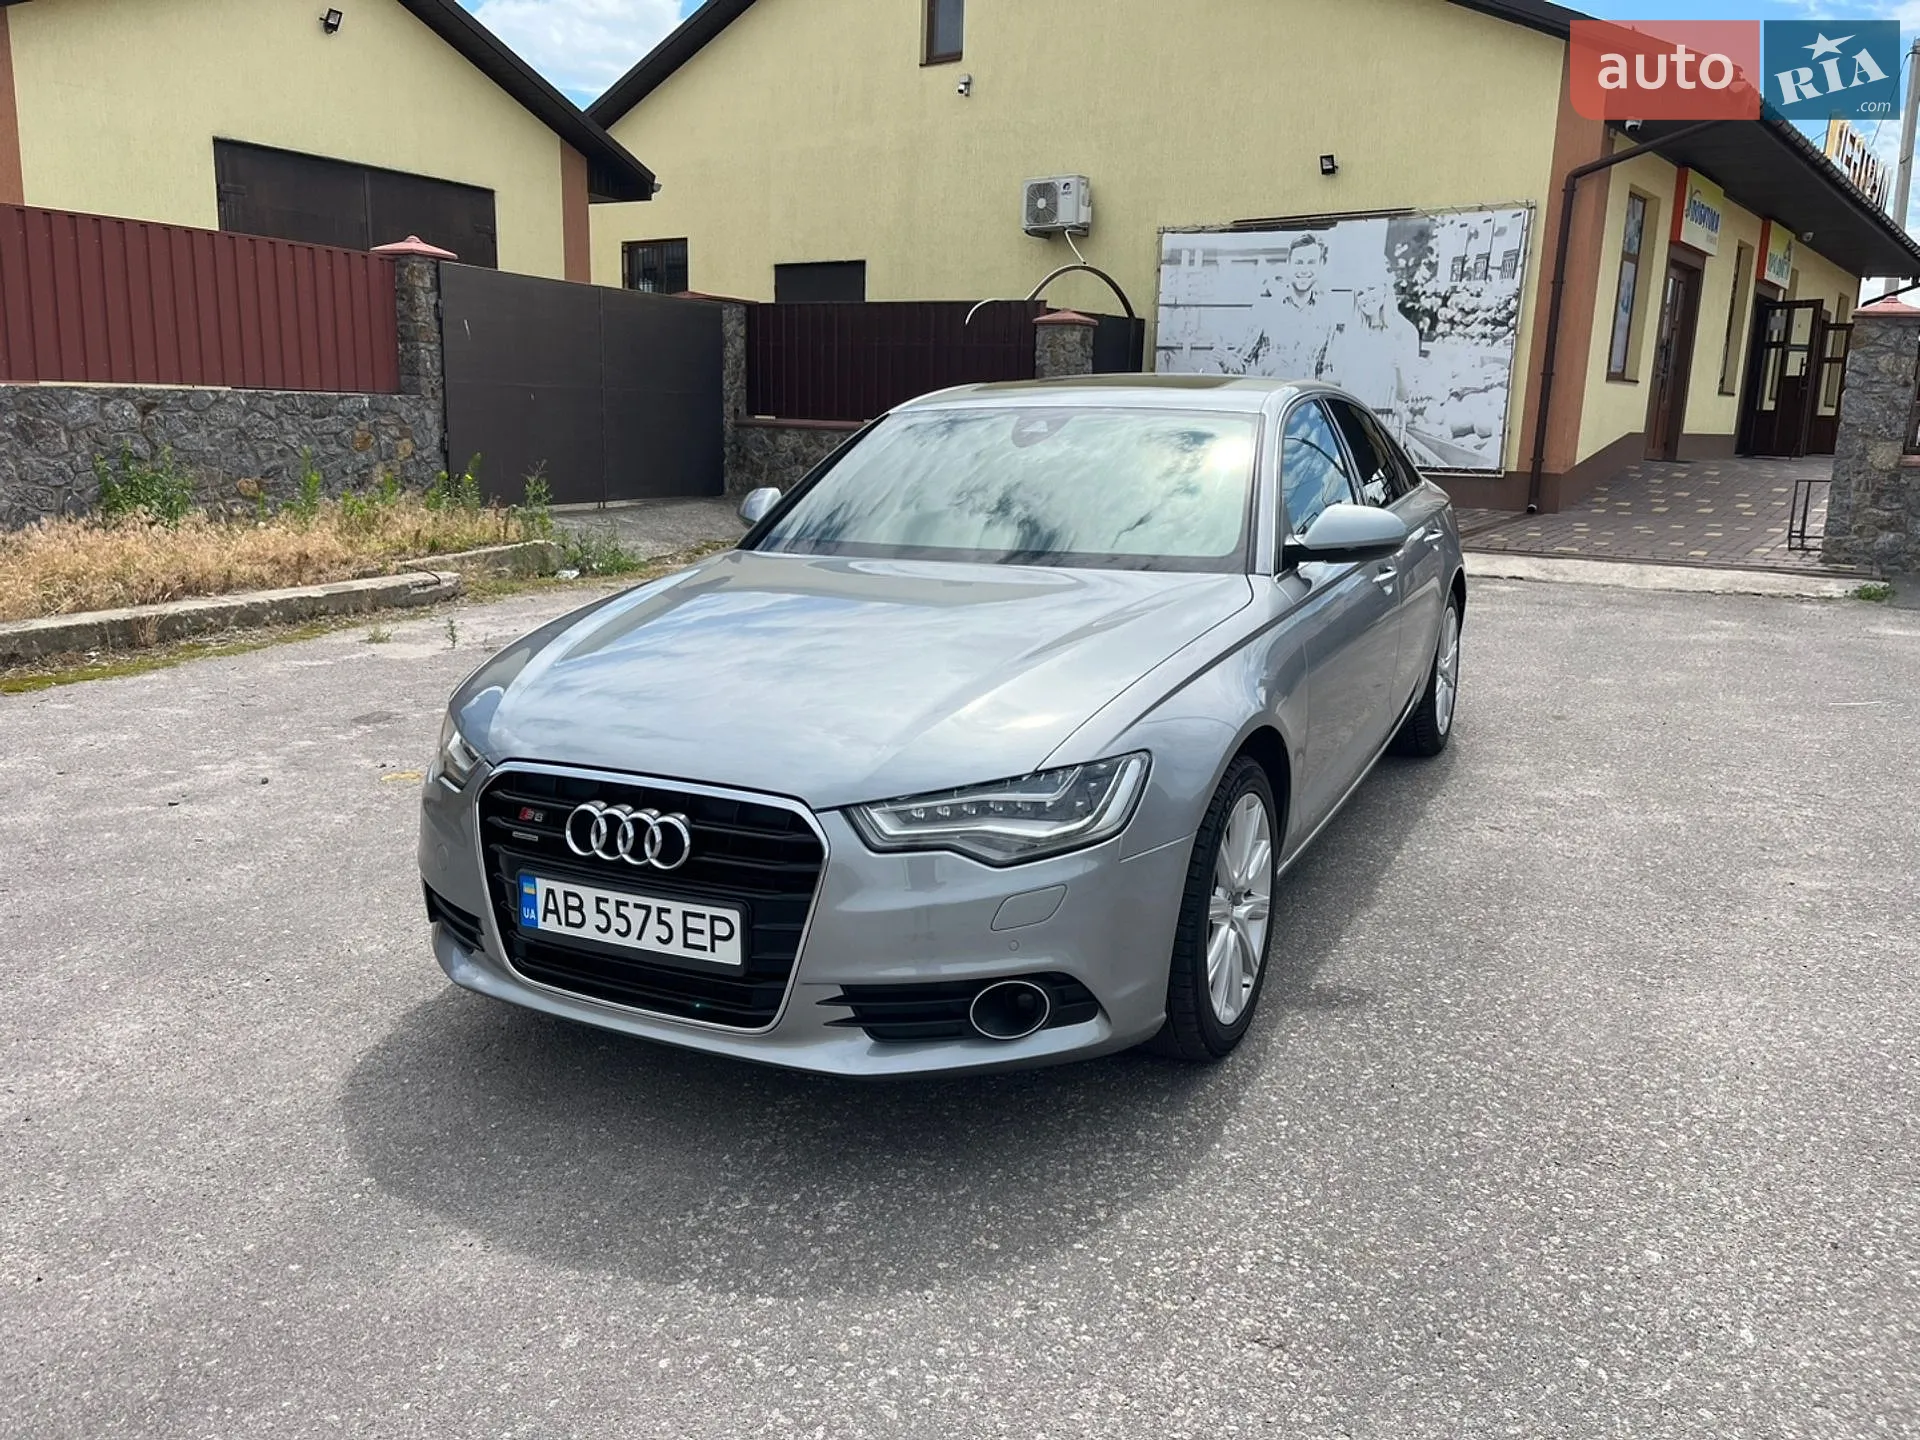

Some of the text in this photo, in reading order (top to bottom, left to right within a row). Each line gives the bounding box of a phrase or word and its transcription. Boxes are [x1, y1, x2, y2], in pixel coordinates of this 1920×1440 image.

[523, 907, 536, 921] UA
[542, 888, 735, 953] AB 5575 EP
